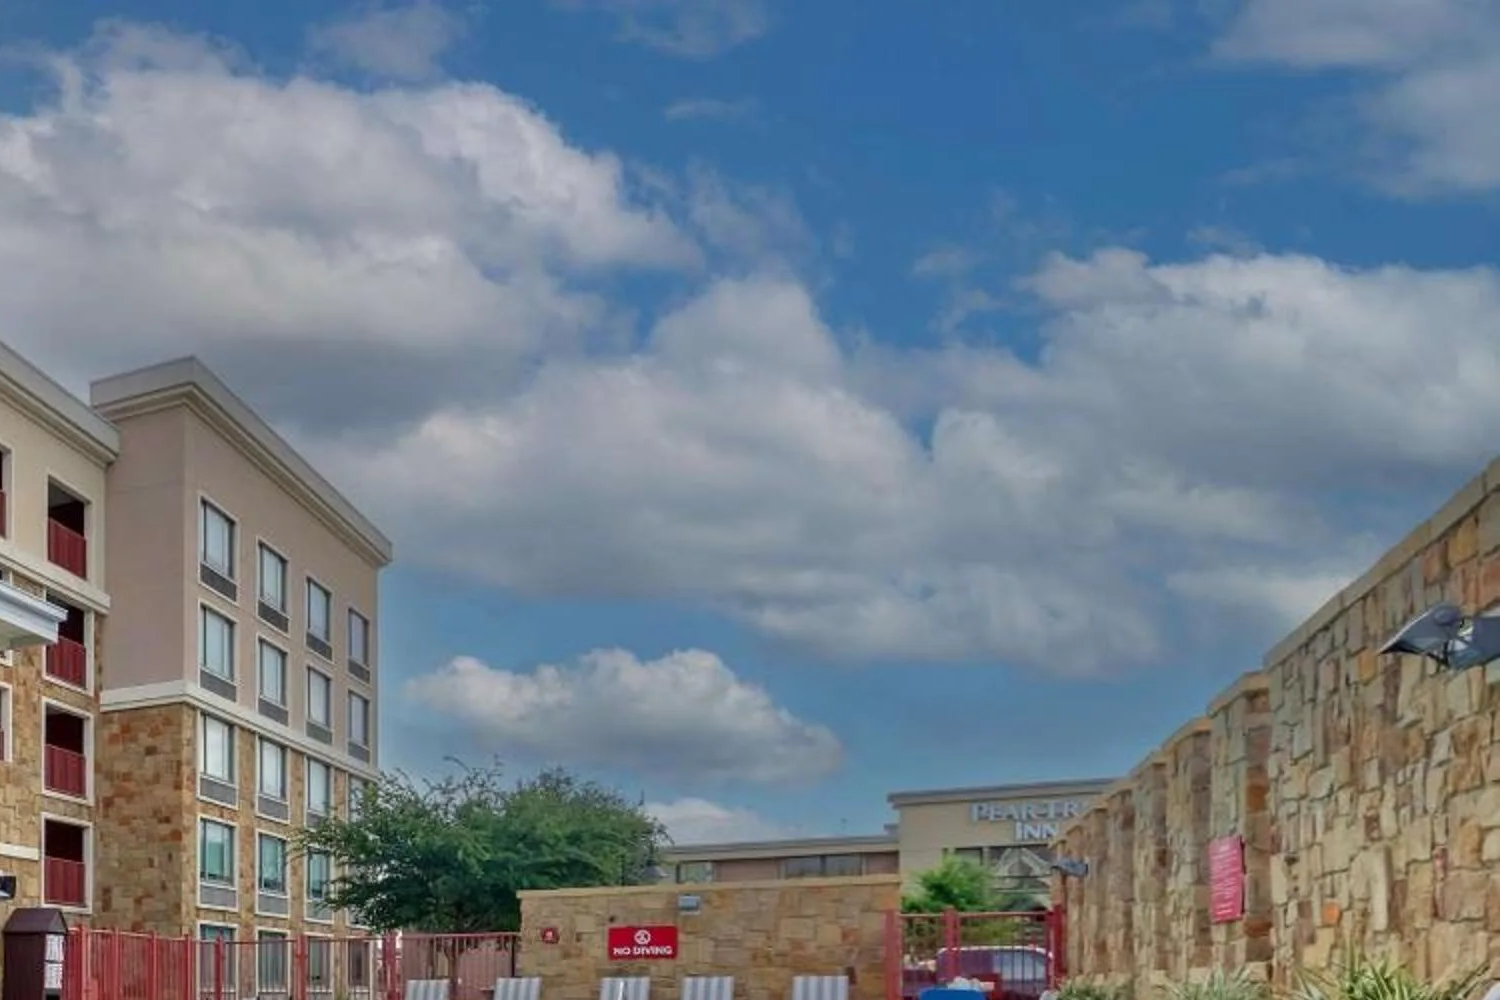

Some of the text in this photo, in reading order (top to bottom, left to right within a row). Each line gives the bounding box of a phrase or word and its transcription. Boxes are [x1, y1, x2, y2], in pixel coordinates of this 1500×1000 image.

[1016, 821, 1059, 840] INN
[613, 945, 673, 955] NO DIVING
